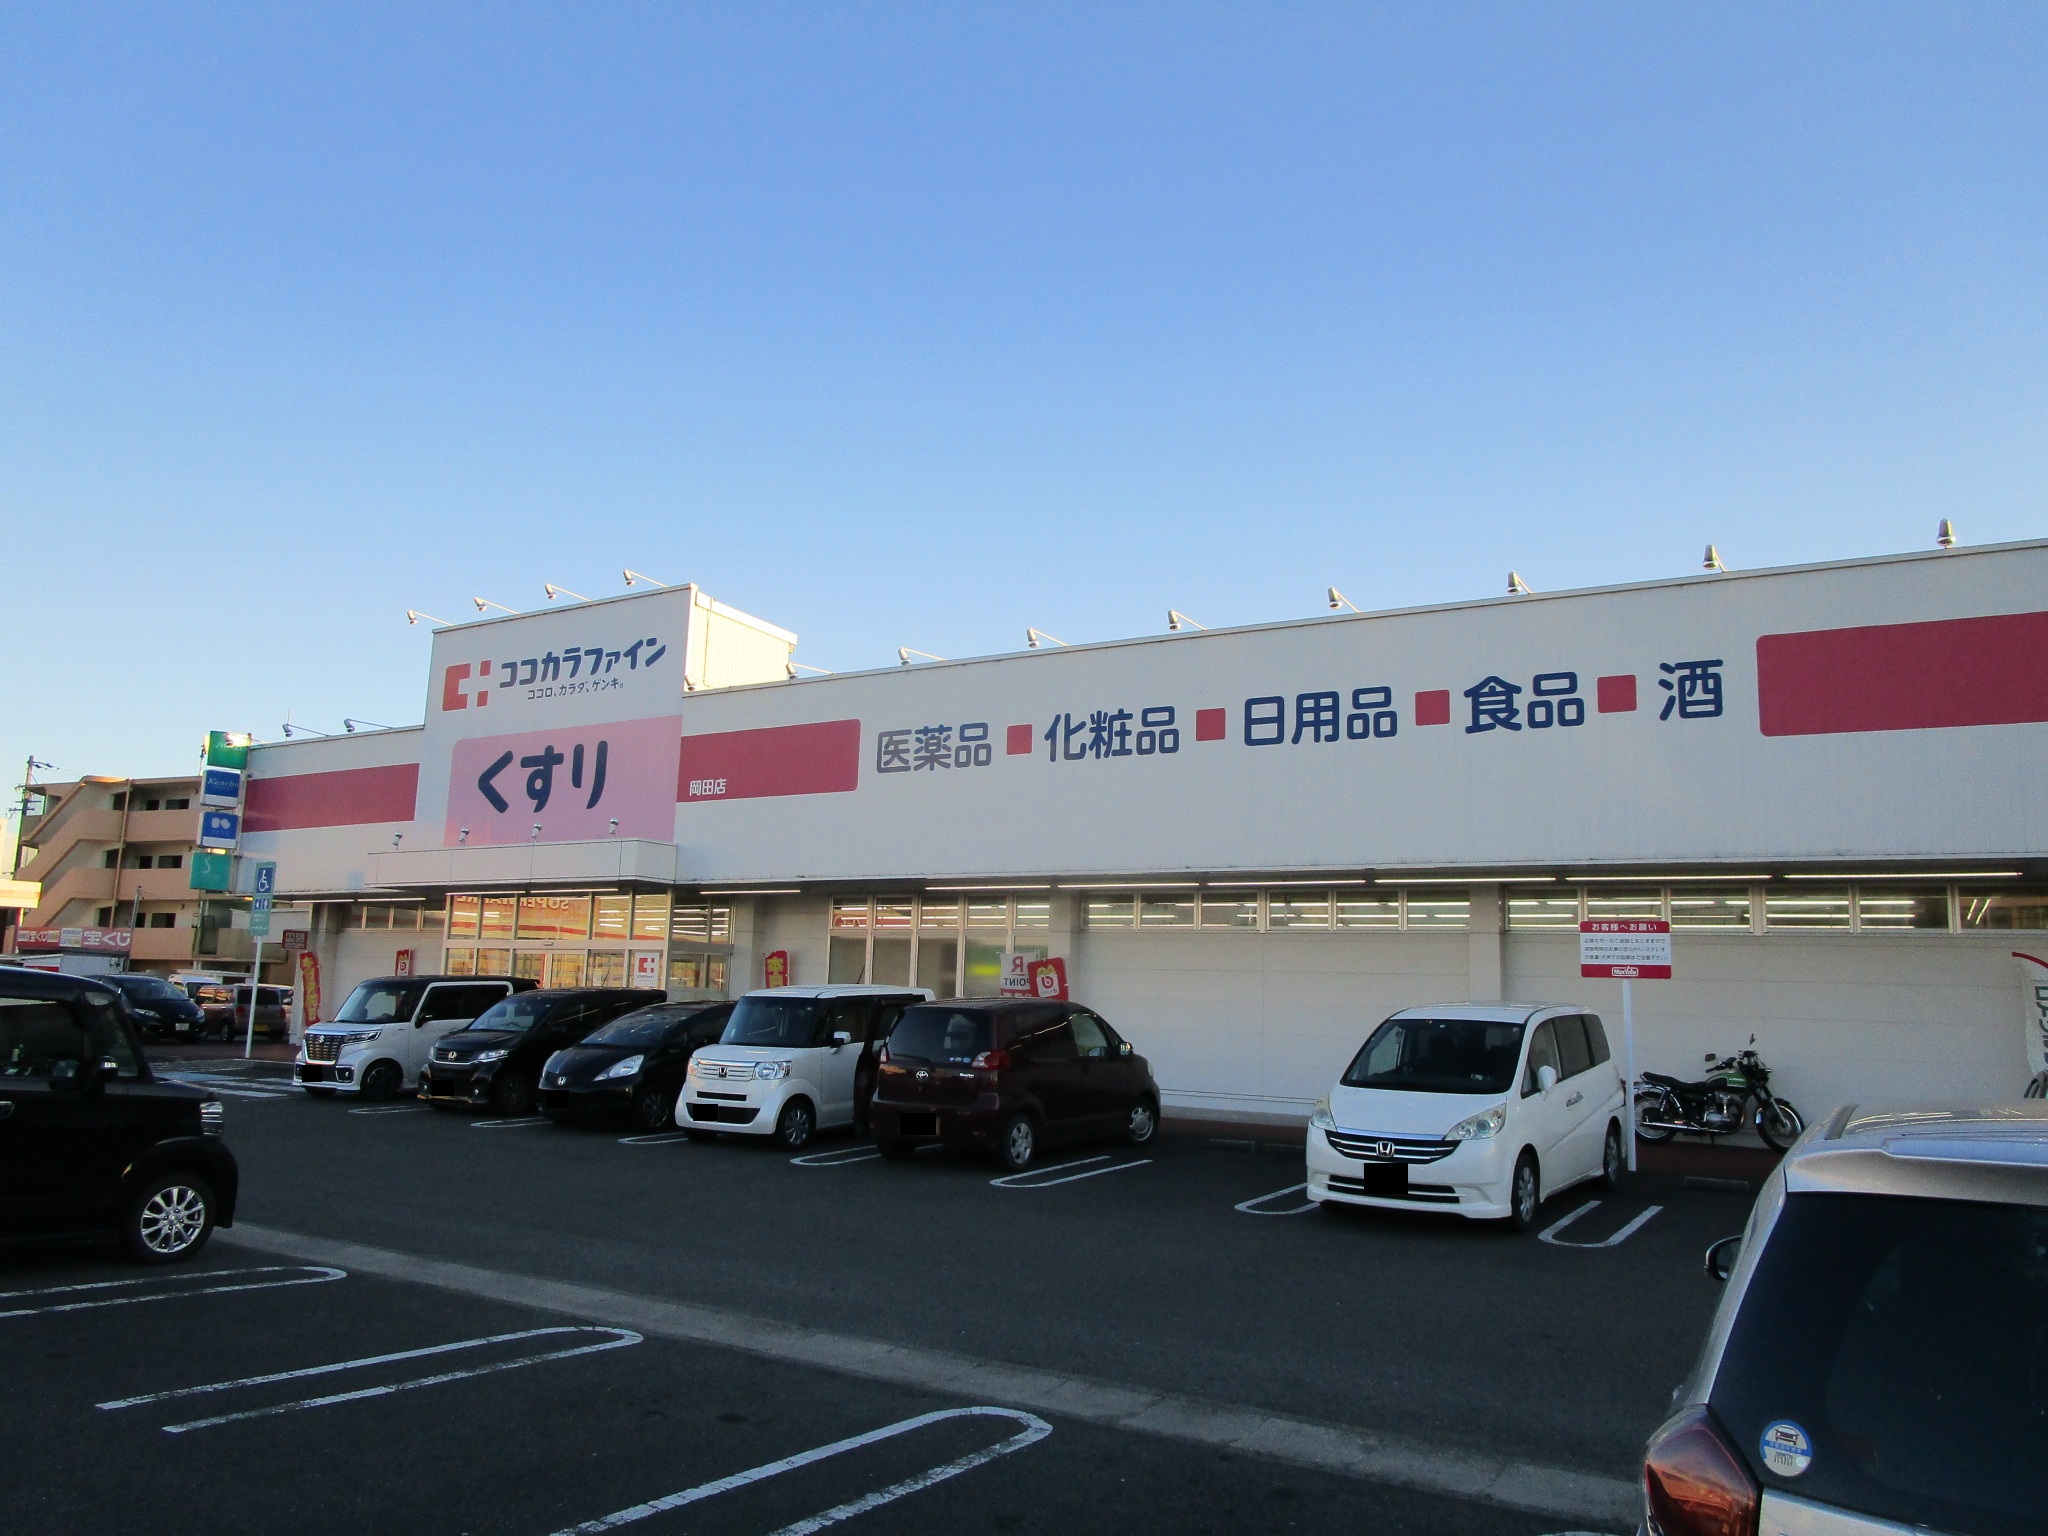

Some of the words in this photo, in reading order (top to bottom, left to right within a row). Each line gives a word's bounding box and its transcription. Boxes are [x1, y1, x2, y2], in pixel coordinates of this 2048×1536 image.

[499, 637, 667, 689] ココカラファイン
[527, 677, 624, 700] ココロ、カラダ、ゲンキ。
[876, 721, 992, 774] 医薬品
[1044, 705, 1180, 763] 化粧品
[1243, 685, 1399, 747] 日用品
[1463, 671, 1585, 735] 食品
[1658, 659, 1724, 721] 酒
[477, 740, 609, 814] くすり
[689, 778, 727, 797] 岡田店
[83, 930, 131, 947] 宝くじ
[1591, 923, 1657, 931] お客様へお願い
